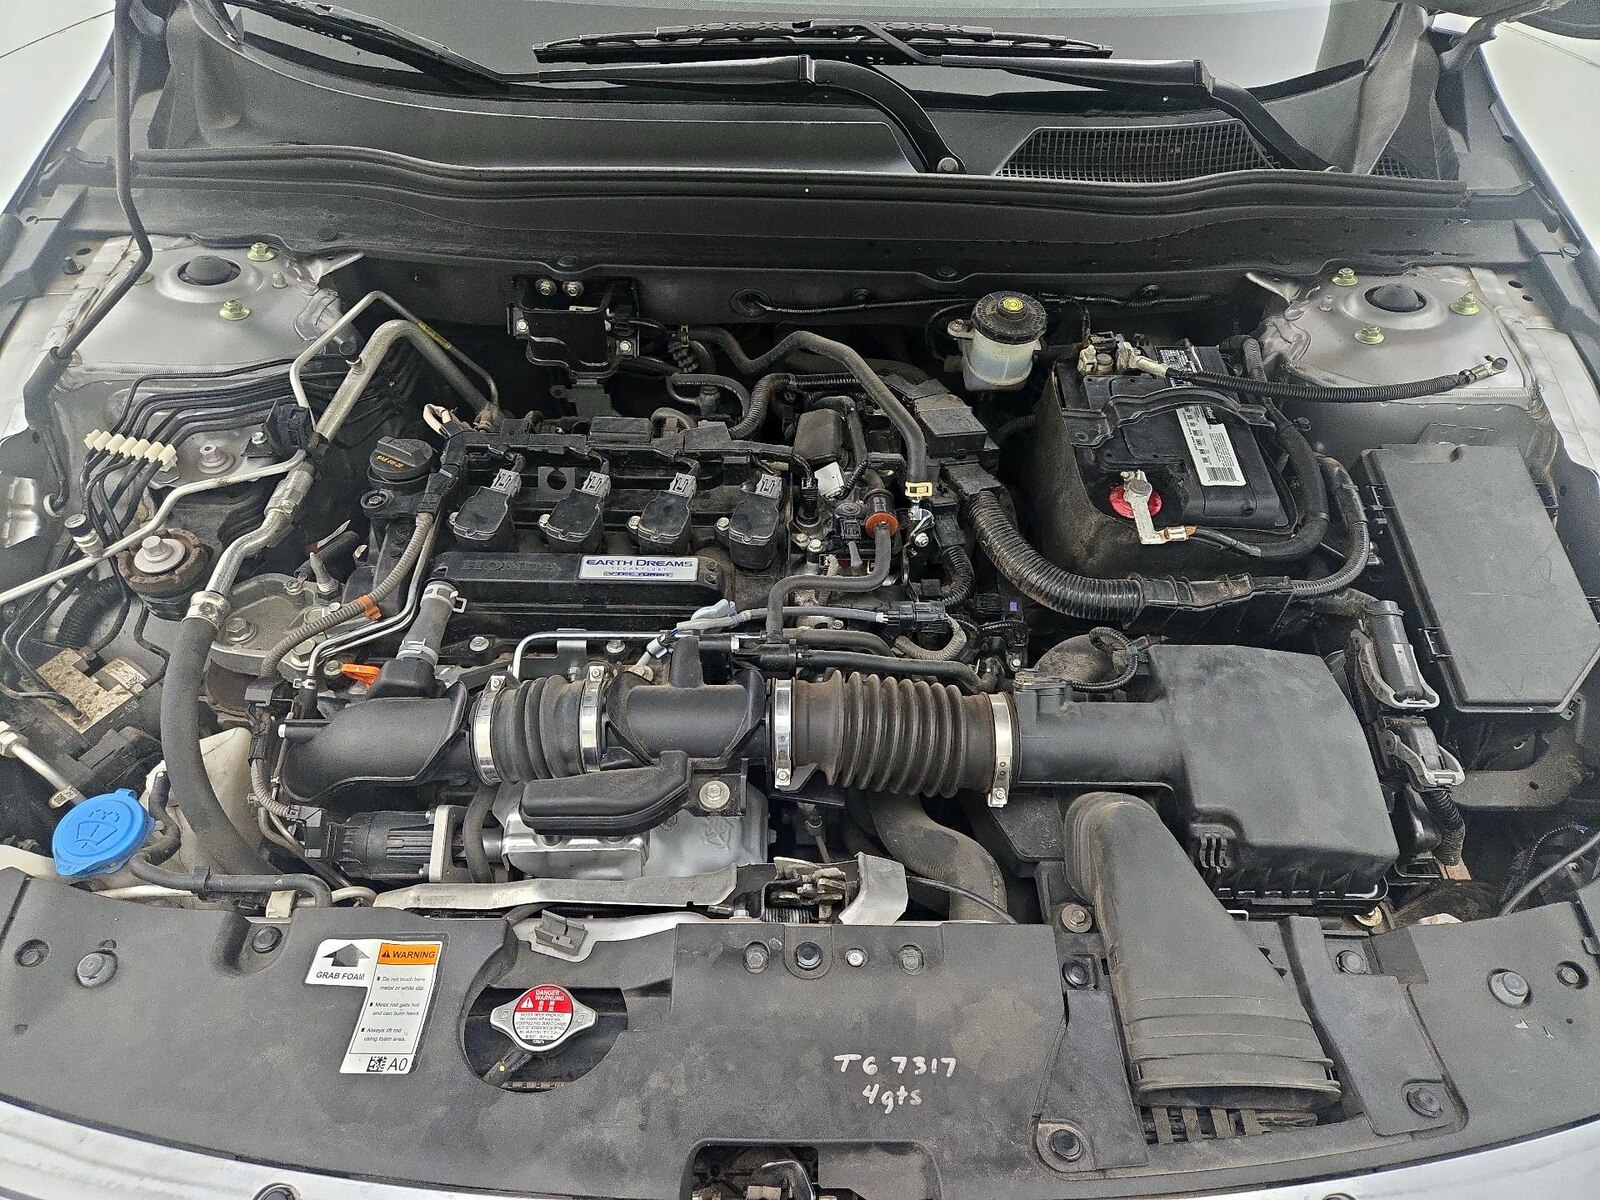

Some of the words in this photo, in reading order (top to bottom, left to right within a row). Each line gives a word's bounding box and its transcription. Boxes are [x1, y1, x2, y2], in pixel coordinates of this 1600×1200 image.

[636, 559, 693, 567] DREAMS
[393, 950, 435, 959] WARNING
[316, 971, 340, 980] GRAB
[341, 972, 365, 981] FOAM
[891, 1056, 957, 1078] 7317
